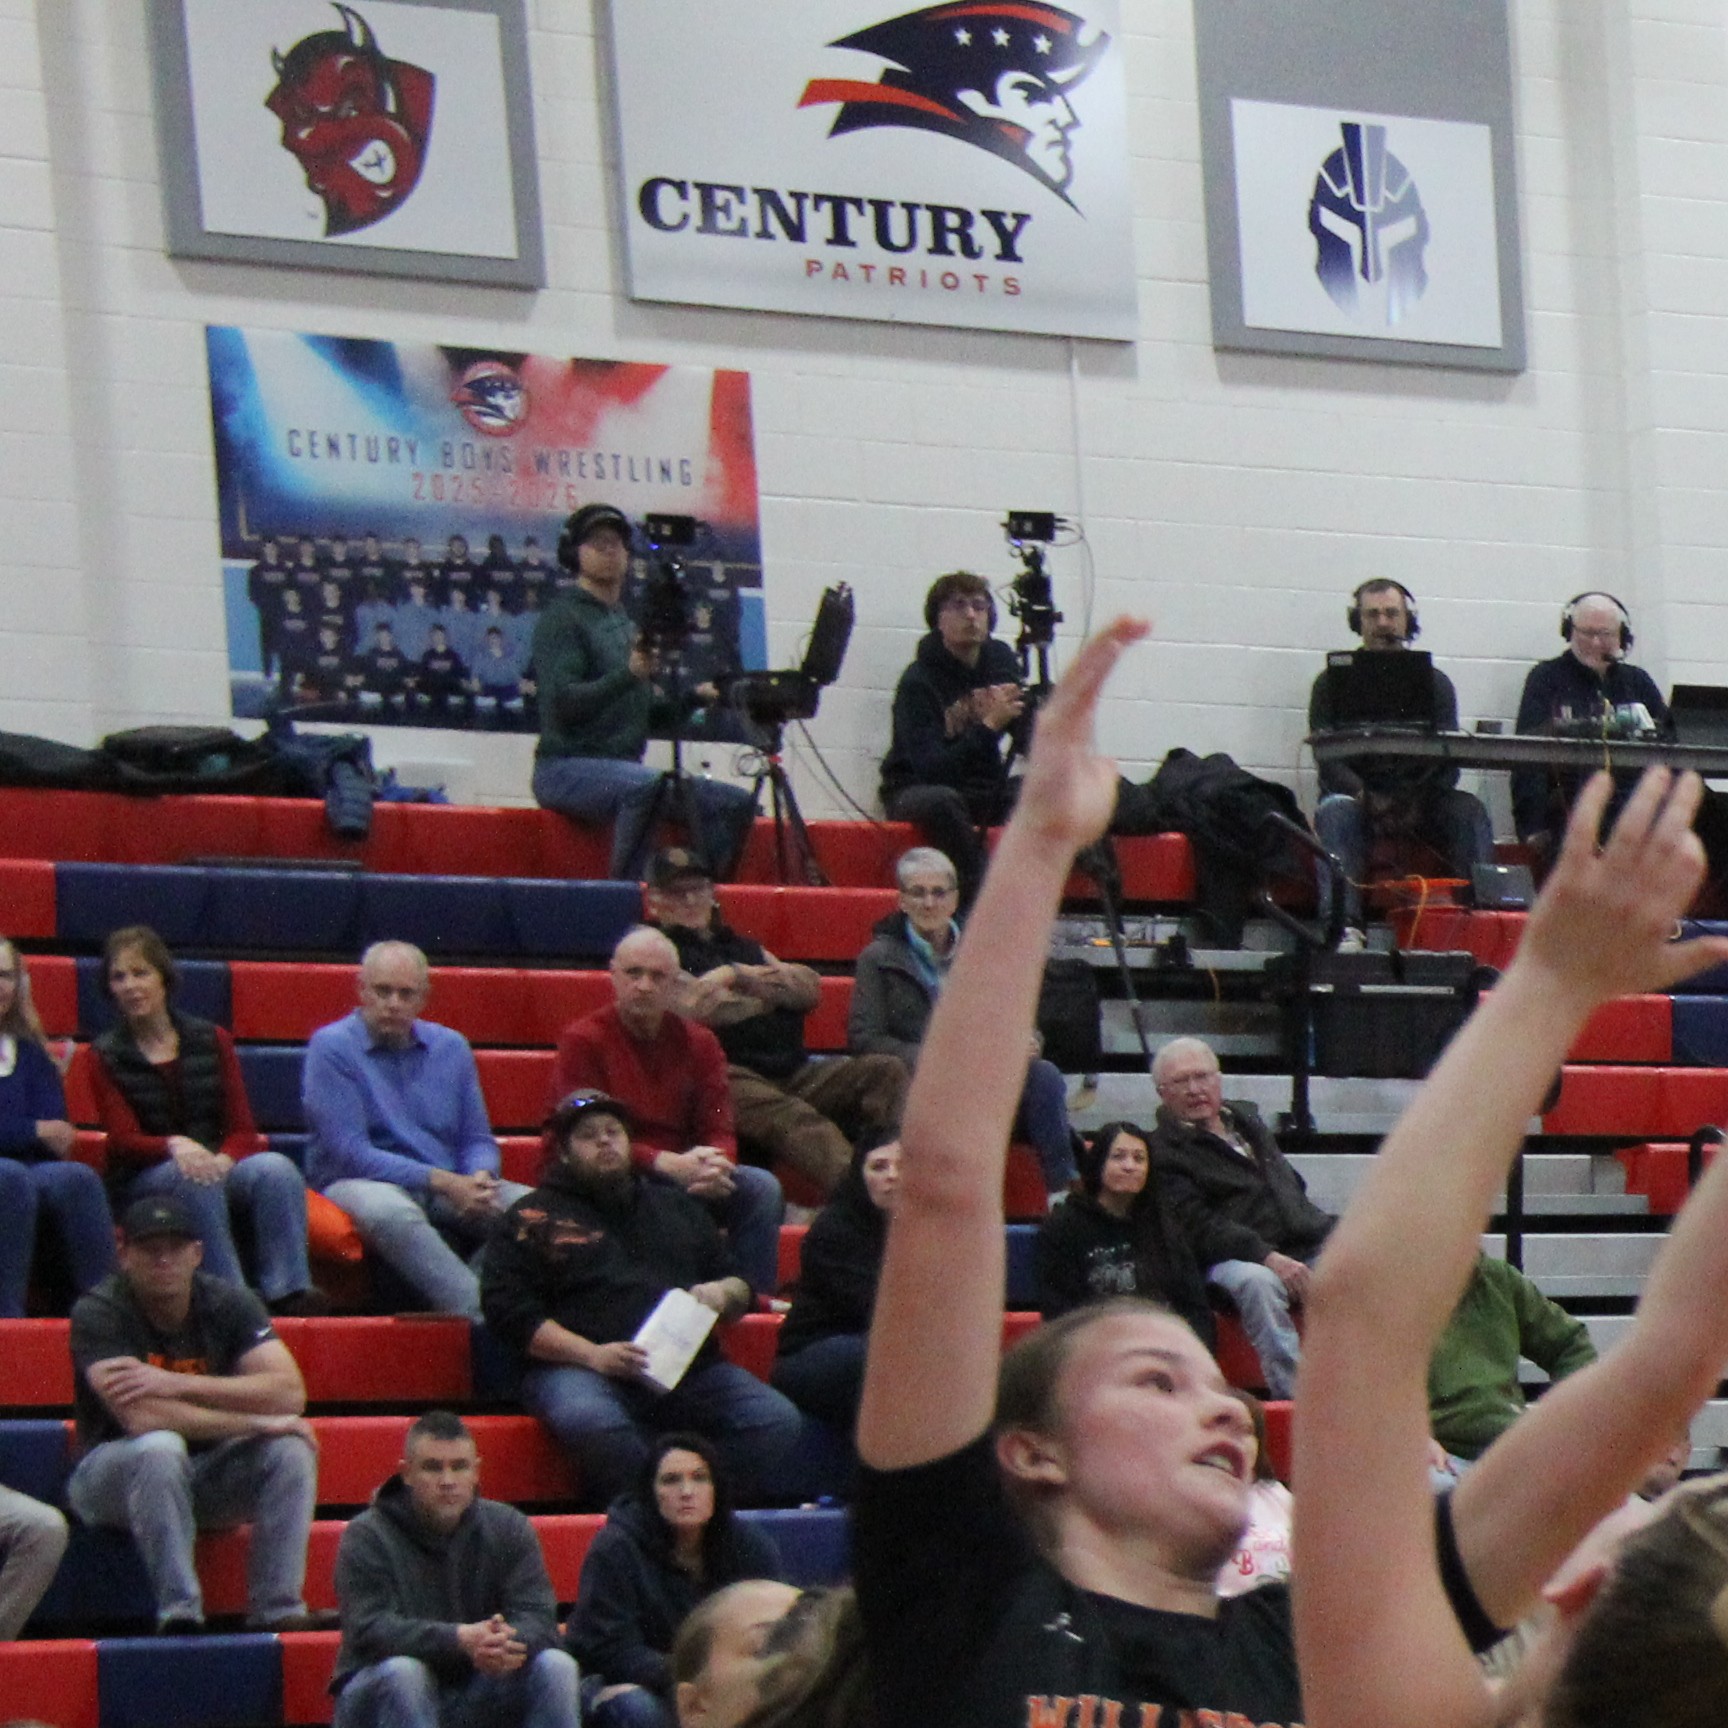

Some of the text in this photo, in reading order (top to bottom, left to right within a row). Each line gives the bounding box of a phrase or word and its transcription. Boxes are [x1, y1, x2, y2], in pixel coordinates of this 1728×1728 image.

[638, 177, 1031, 262] CENTURY
[804, 259, 1021, 296] PATRIOTS
[287, 429, 693, 487] CENTURY BOYS WRESTLING
[411, 471, 580, 511] 2025-2026
